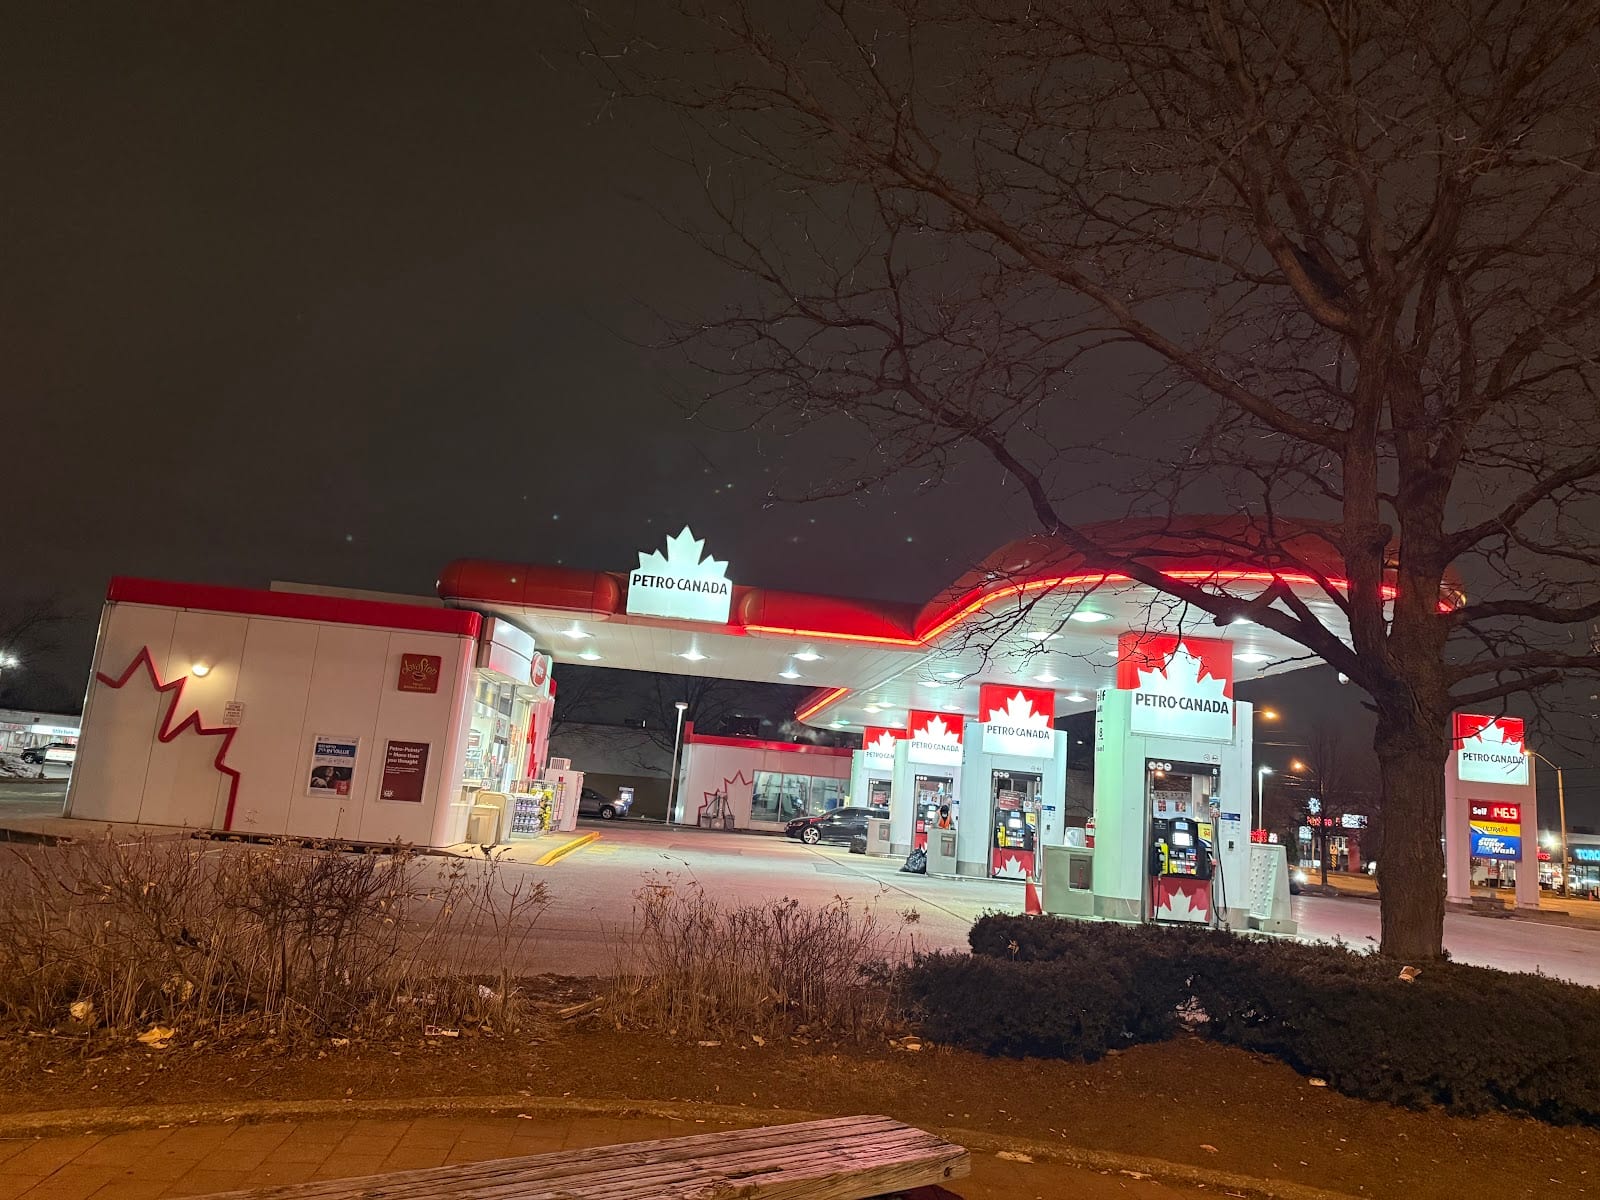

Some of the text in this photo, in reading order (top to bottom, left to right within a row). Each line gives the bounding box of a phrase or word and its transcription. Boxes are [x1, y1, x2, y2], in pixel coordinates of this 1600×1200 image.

[632, 573, 728, 595] PETRO-CANADA
[1135, 692, 1229, 714] PETRO-CANADA
[1472, 806, 1487, 815] Self
[1491, 846, 1516, 855] Wash
